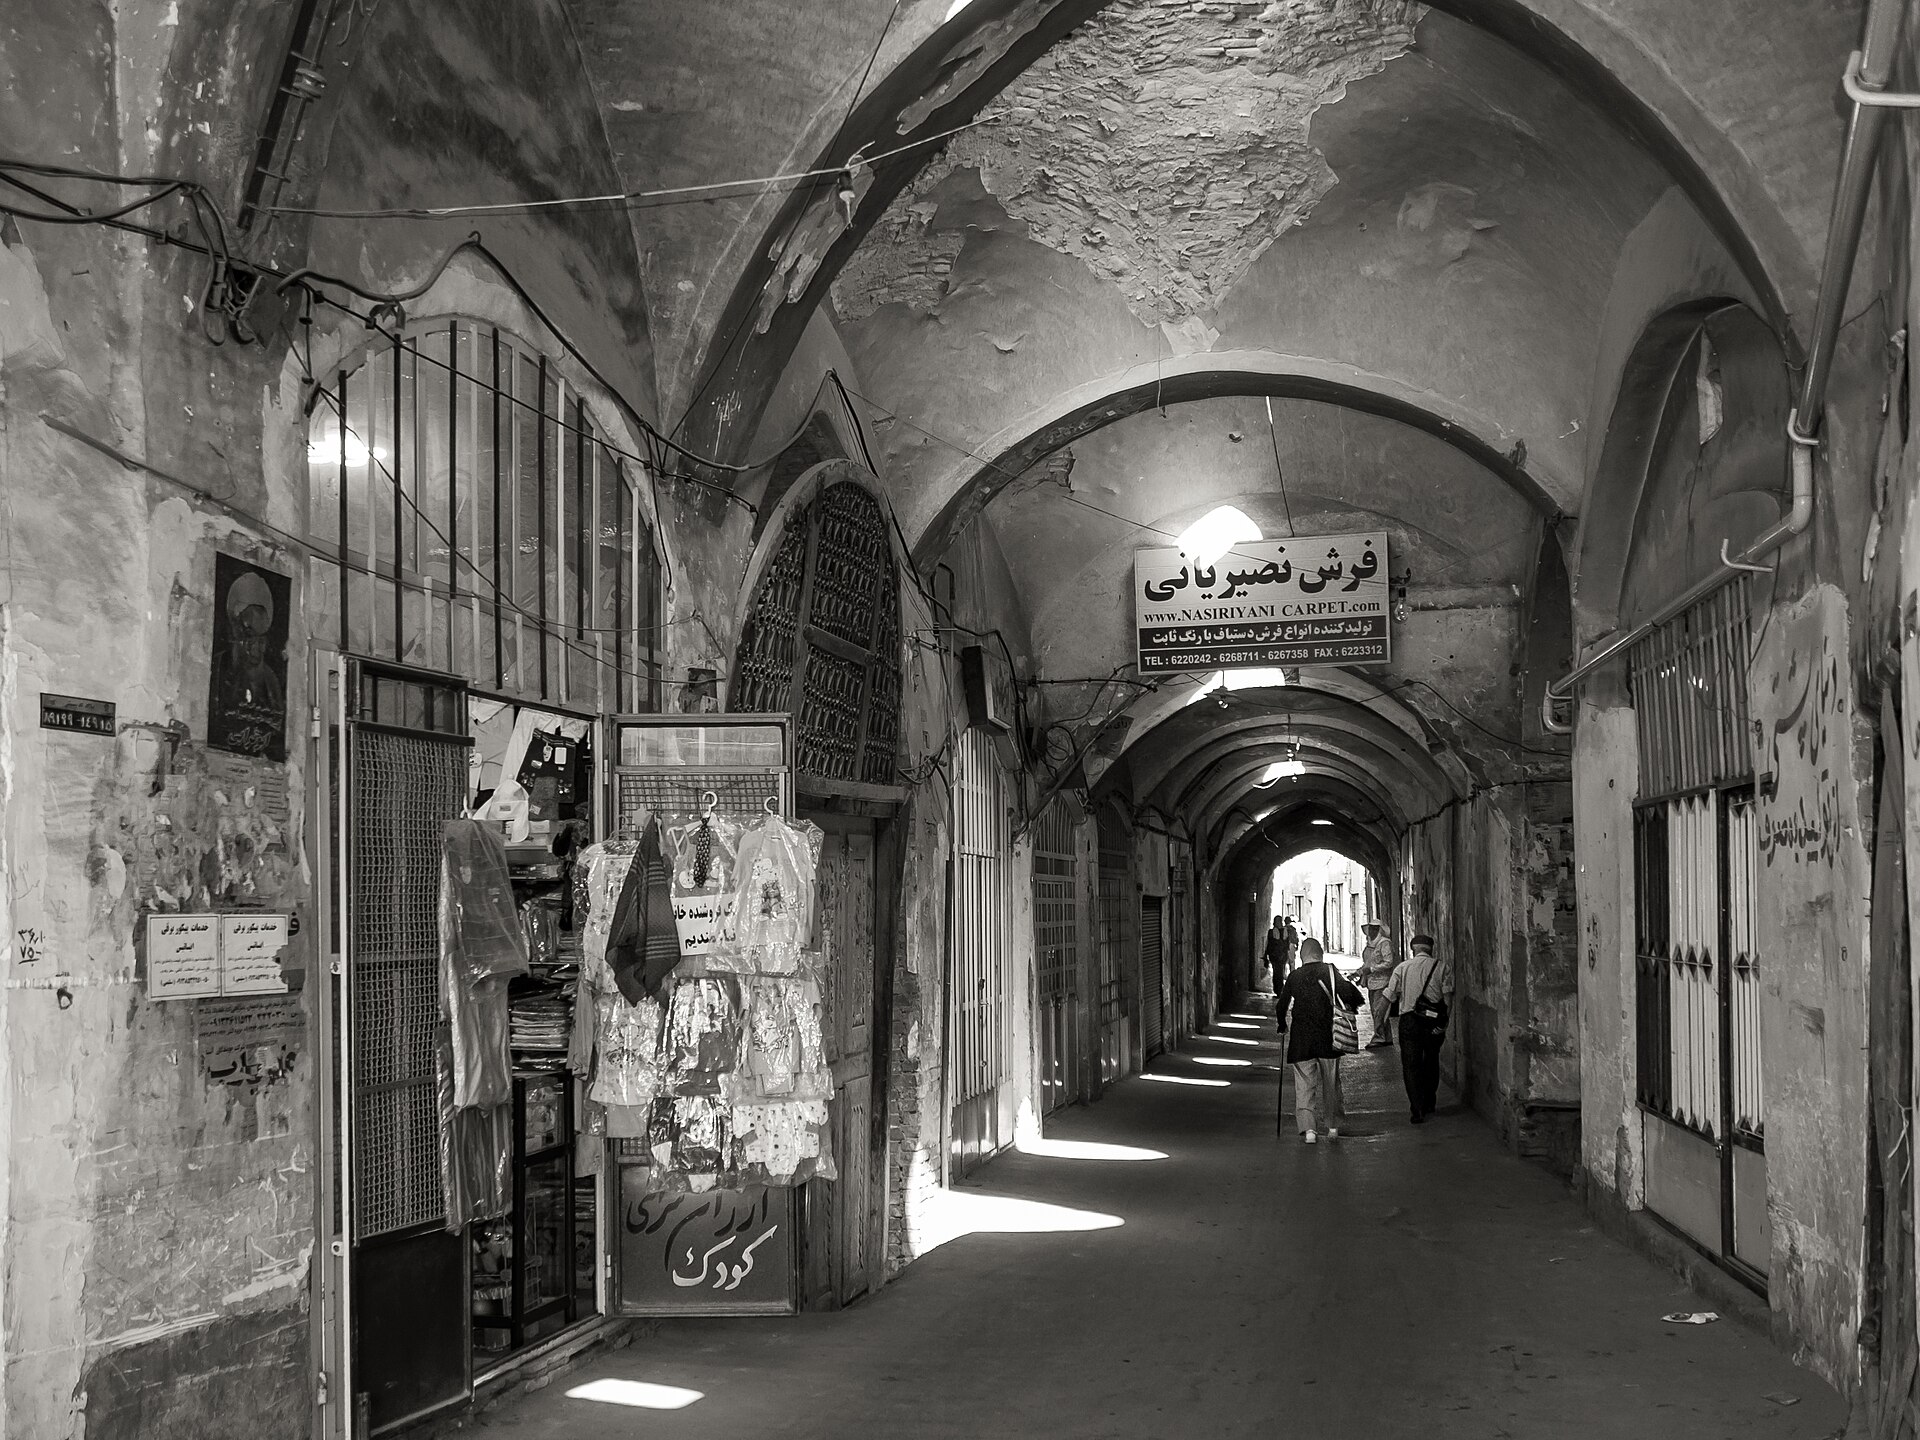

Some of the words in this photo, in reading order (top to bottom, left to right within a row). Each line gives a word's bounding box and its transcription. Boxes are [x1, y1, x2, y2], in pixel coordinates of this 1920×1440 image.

[1299, 539, 1379, 594] فرش
[1144, 605, 1275, 623] www.NASIRIYANI
[1282, 601, 1380, 617] CARPET.com
[1152, 629, 1177, 646] ثابت
[1179, 630, 1202, 645] رنگ
[1204, 629, 1212, 644] با
[1213, 627, 1254, 642] دستباف
[1255, 624, 1282, 641] فرش
[1284, 623, 1312, 640] انواع
[1171, 654, 1211, 665] 6220242
[1219, 651, 1259, 662] 6268711
[1268, 649, 1309, 660] 6267358
[1341, 645, 1383, 656] 6223312
[672, 1225, 777, 1291] کودک
